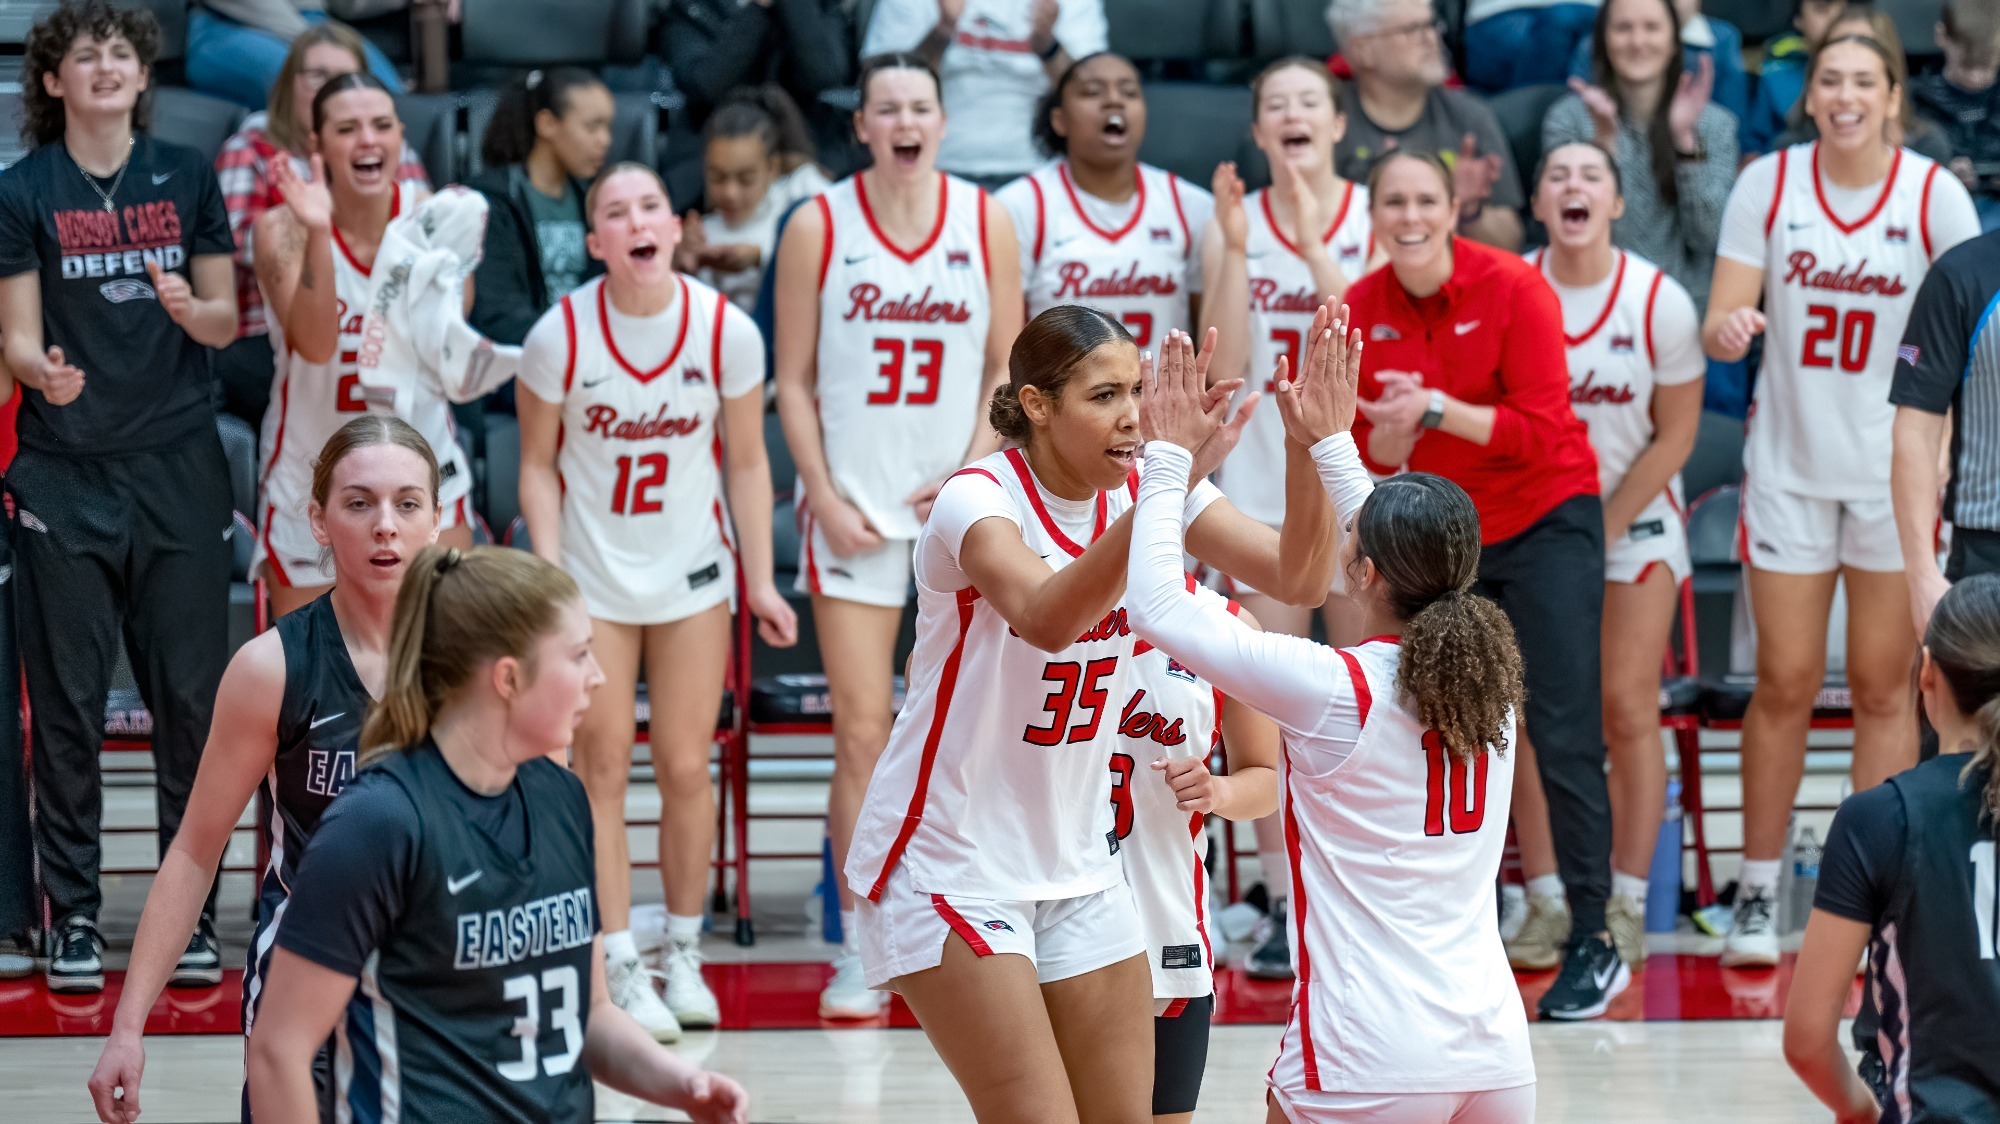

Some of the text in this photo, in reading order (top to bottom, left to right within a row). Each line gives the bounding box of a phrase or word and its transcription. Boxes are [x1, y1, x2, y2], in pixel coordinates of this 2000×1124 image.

[61, 244, 185, 279] DEFEND
[1053, 260, 1178, 297] Raiders
[1784, 250, 1907, 296] Raiders
[842, 282, 972, 324] Raiders
[865, 337, 945, 406] 33
[1800, 304, 1876, 373] 20
[583, 402, 702, 440] Raiders
[611, 452, 669, 516] 12
[1022, 655, 1119, 746] 35
[1421, 729, 1489, 836] 10
[453, 886, 594, 971] EASTERN
[496, 964, 584, 1082] 33
